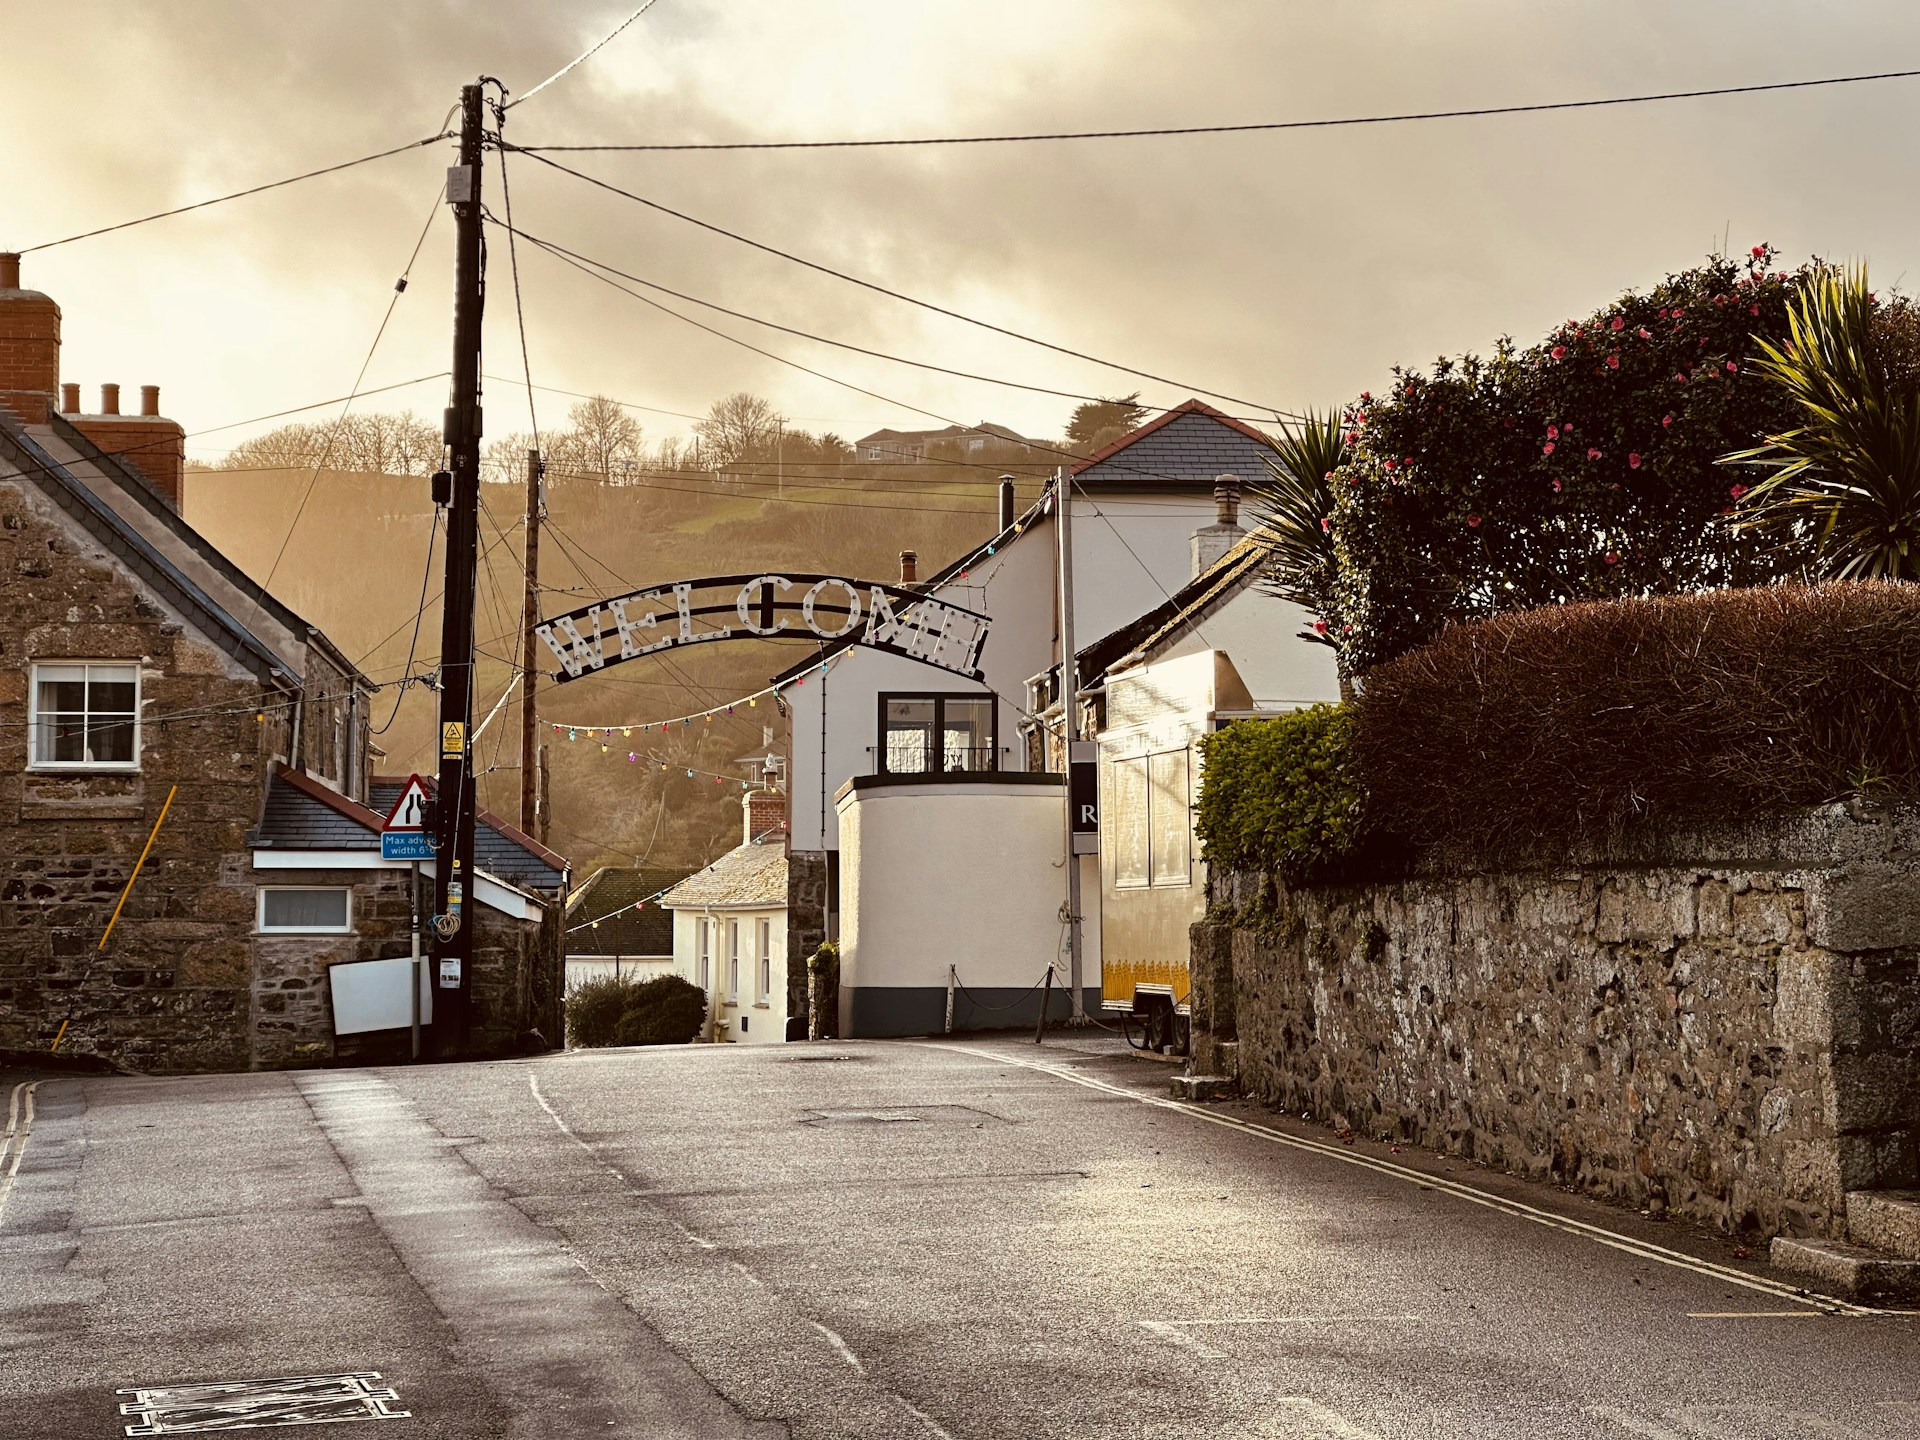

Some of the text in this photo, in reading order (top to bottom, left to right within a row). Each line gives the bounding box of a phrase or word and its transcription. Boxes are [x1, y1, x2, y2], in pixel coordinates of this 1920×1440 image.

[535, 577, 992, 677] WELCOME
[385, 836, 405, 845] Max
[391, 846, 416, 855] width
